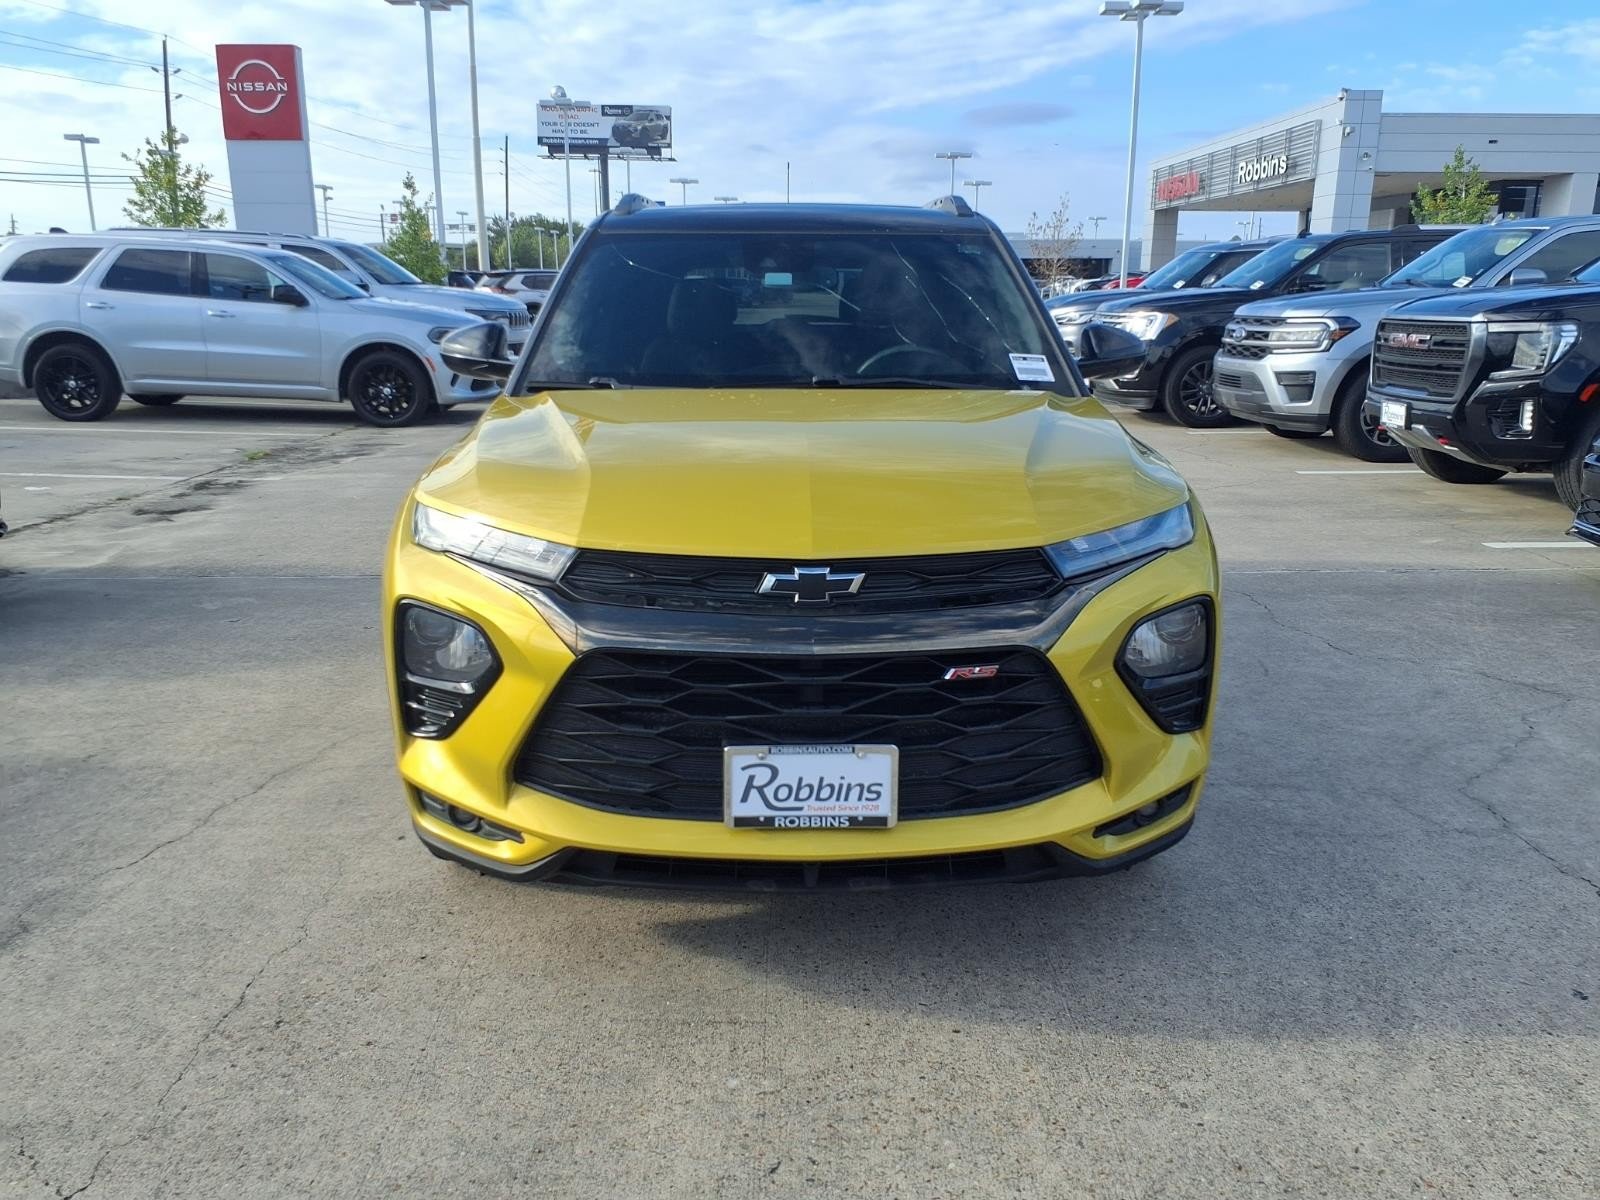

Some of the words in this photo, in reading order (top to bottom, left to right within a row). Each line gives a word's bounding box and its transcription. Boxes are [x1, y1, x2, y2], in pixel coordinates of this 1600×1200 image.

[226, 82, 288, 92] NISSAN
[1237, 154, 1288, 185] Robbins
[1157, 171, 1199, 200] NISSAN
[1390, 333, 1430, 348] GMC
[944, 664, 999, 680] RS
[770, 746, 853, 754] ROBBINSAUTO.COM
[740, 763, 884, 812] Robbins
[807, 804, 837, 812] Trusted
[838, 804, 859, 812] Since
[861, 804, 880, 812] 1928
[774, 816, 850, 828] ROBBINS
